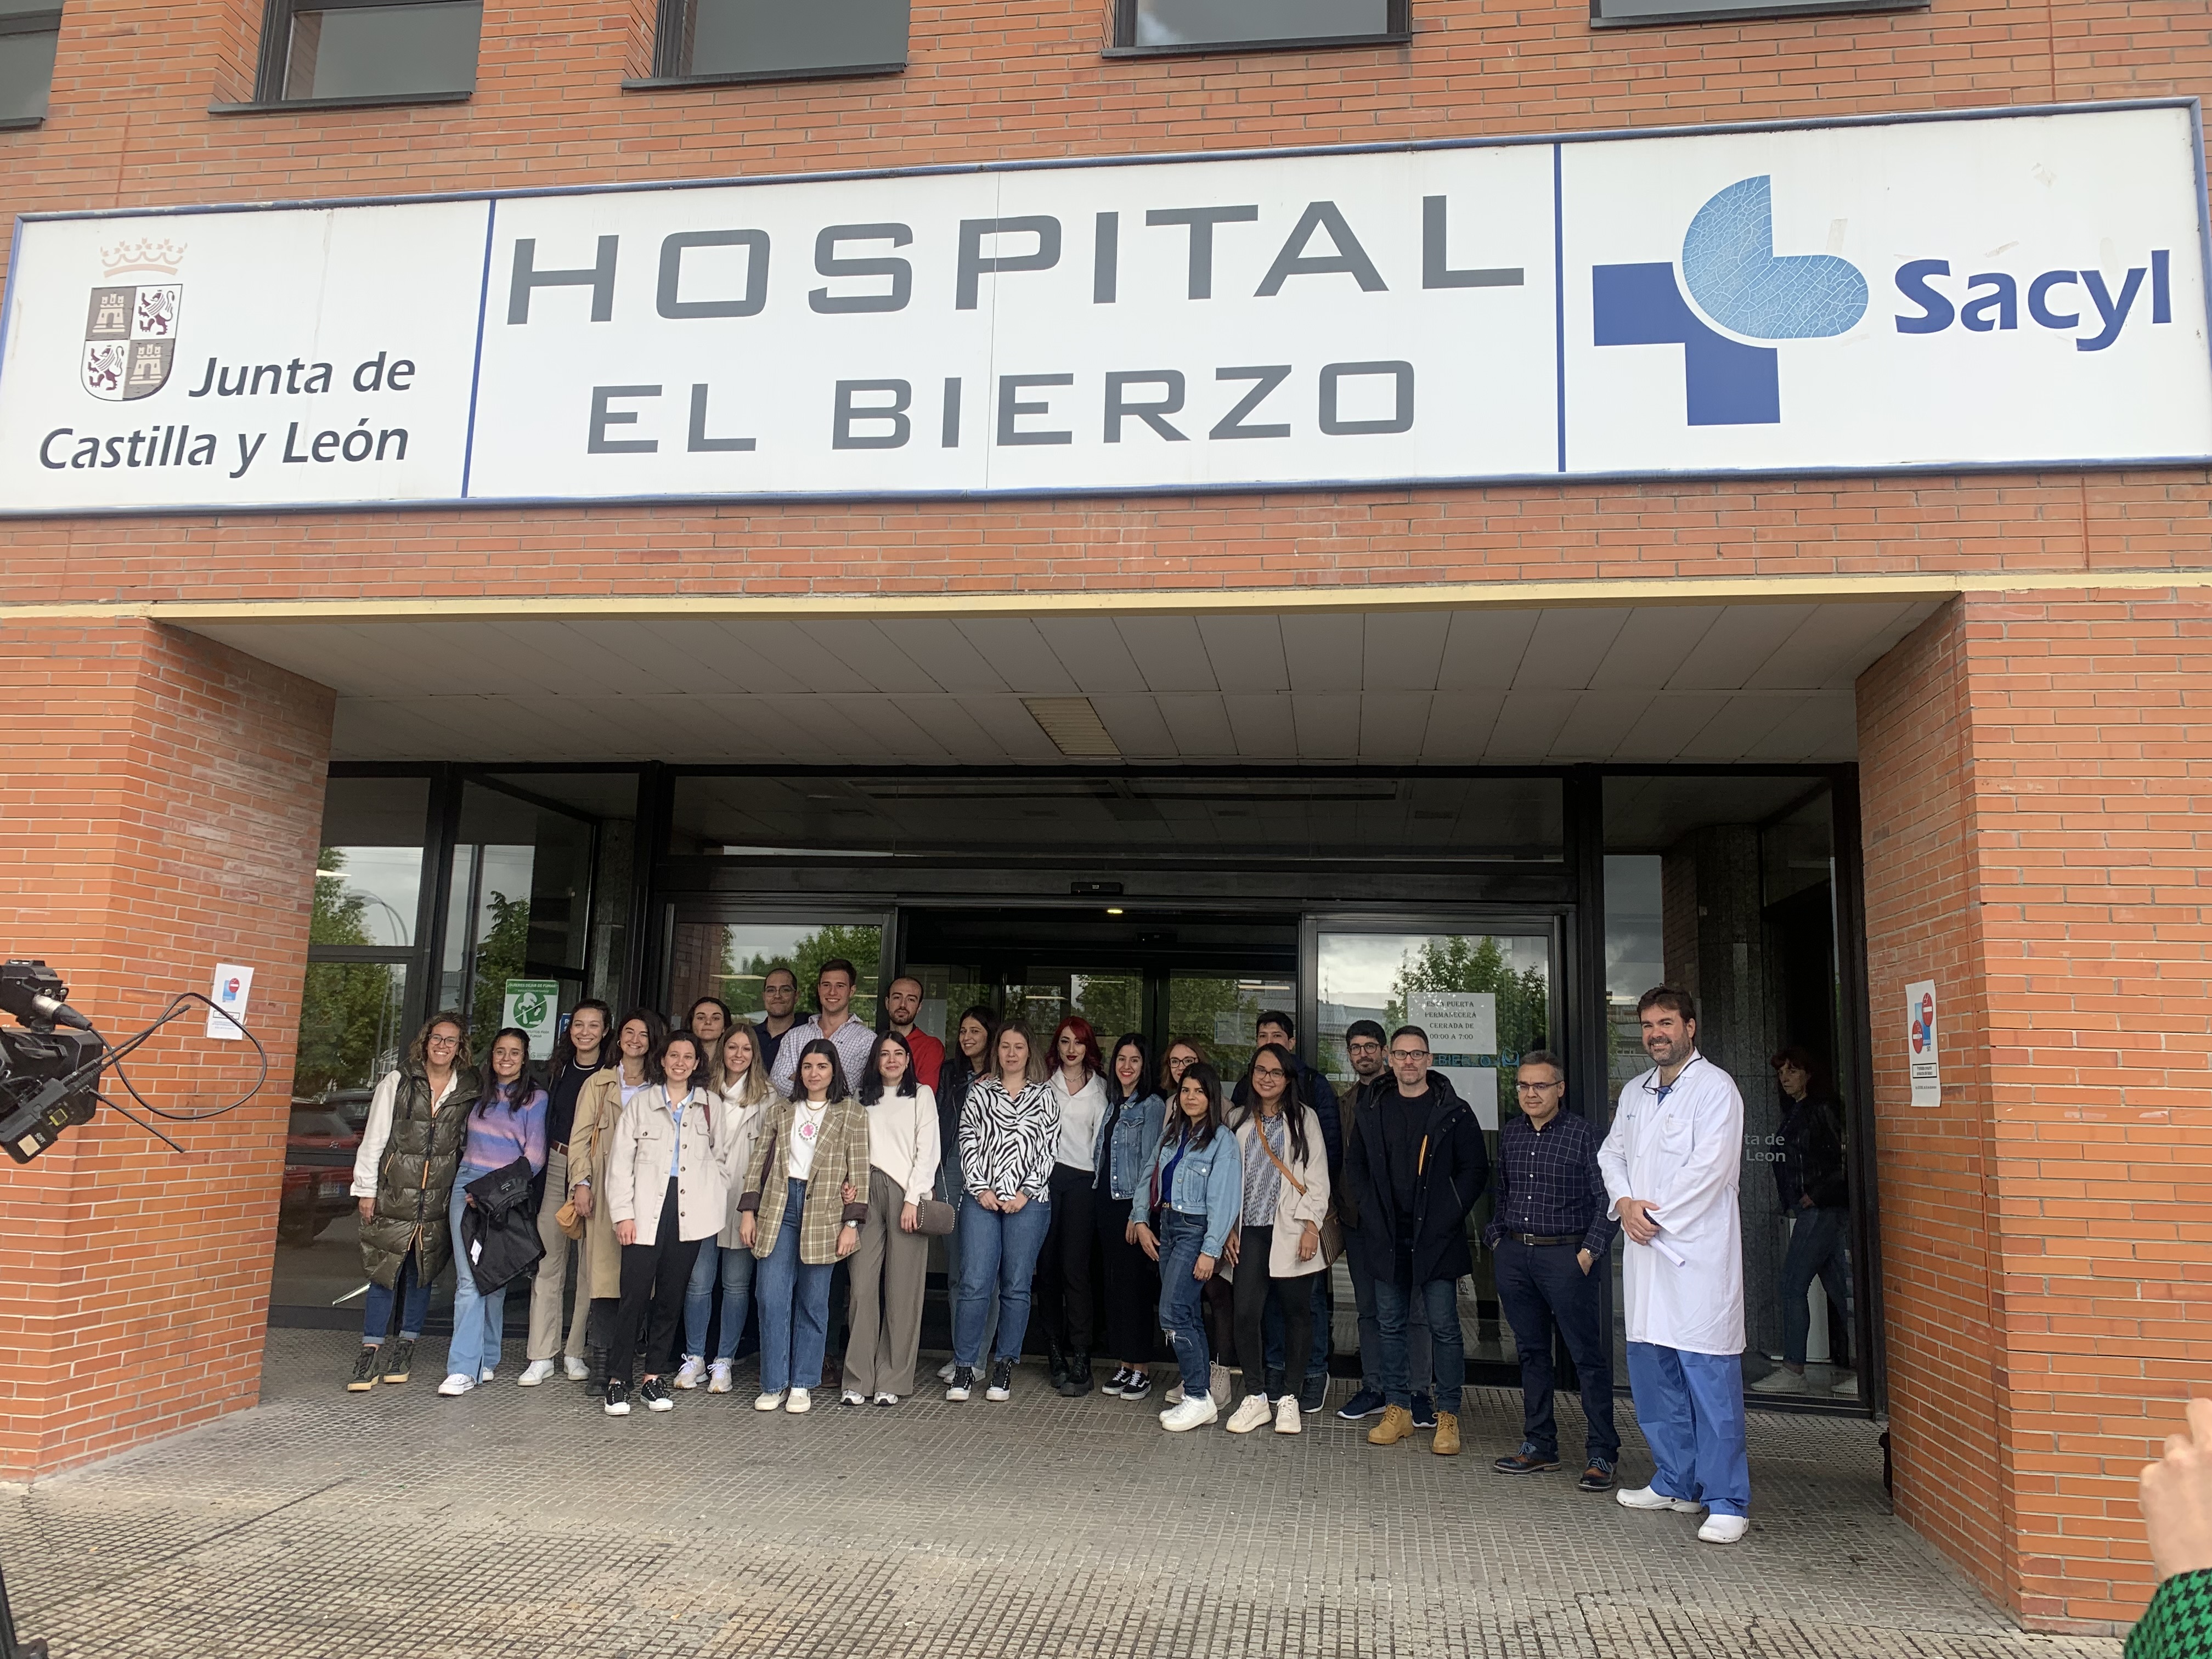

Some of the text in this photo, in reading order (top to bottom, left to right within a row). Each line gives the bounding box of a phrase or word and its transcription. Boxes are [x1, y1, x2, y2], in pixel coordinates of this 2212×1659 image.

[507, 195, 1525, 325] HOSPITAL
[1894, 249, 2172, 352] Sacyl
[188, 351, 415, 398] Junta de
[587, 360, 1414, 454] EL BIERZO
[40, 417, 408, 478] Castilla y León
[1764, 1133, 1785, 1146] de
